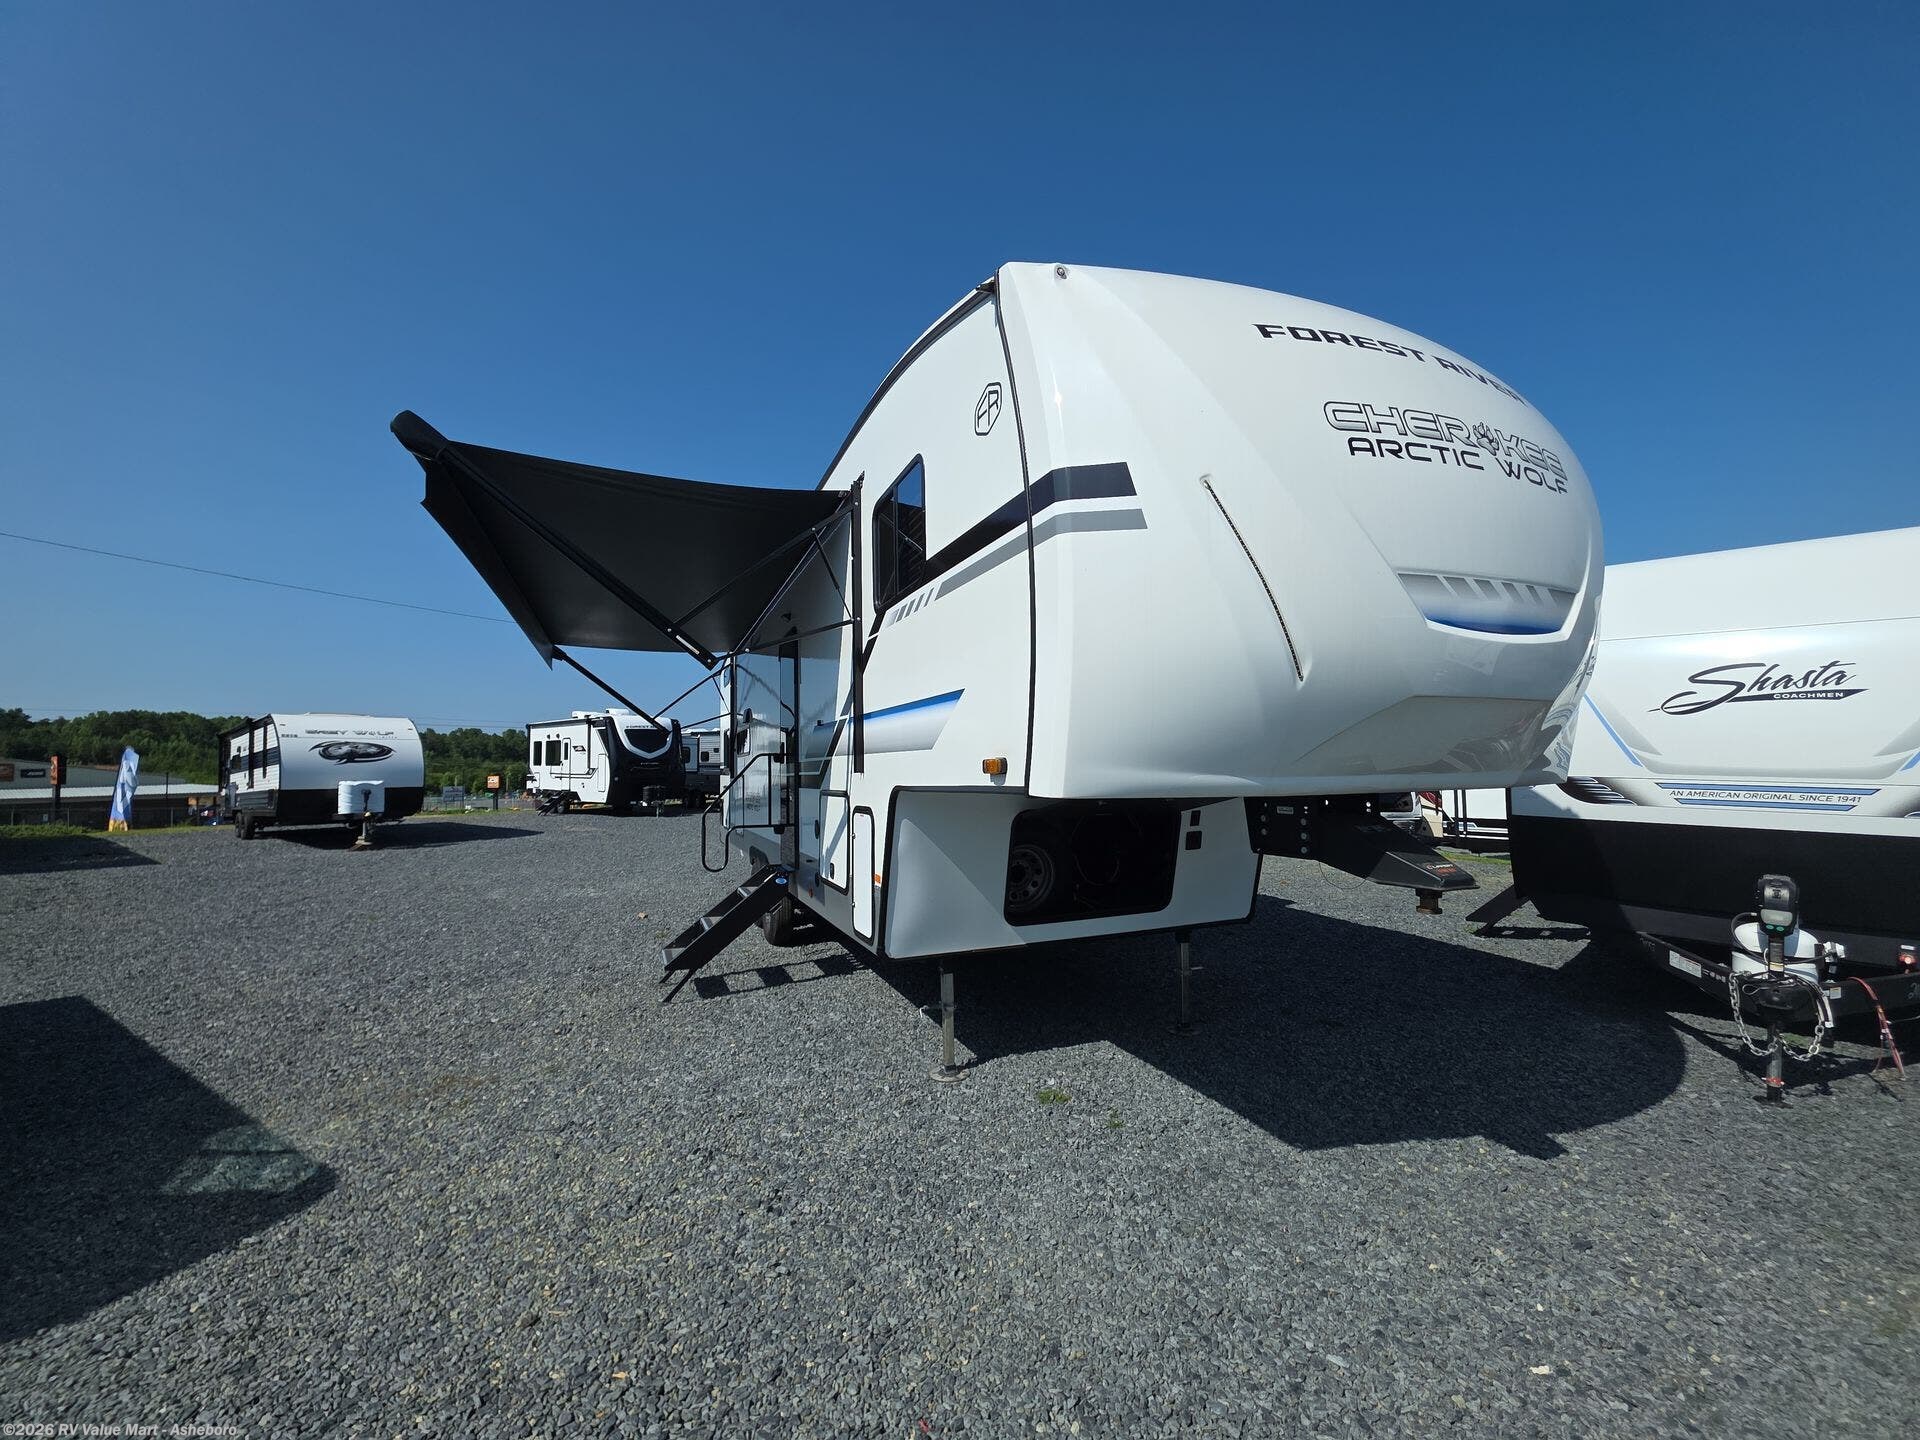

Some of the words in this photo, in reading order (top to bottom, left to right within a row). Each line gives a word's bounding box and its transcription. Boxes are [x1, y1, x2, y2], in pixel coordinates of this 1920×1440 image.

[1252, 323, 1426, 362] FOREST
[1432, 355, 1528, 406] RIVER
[1348, 437, 1485, 471] ARCTIC
[1495, 458, 1568, 495] WOLF
[1660, 659, 1857, 716] Shasta
[1773, 691, 1844, 700] COACHMEN
[1669, 790, 1686, 798] AN
[1686, 790, 1741, 800] AMERICAN
[1743, 792, 1796, 801] ORIGINAL
[1798, 794, 1834, 803] SINCE
[1837, 795, 1862, 804] 1941
